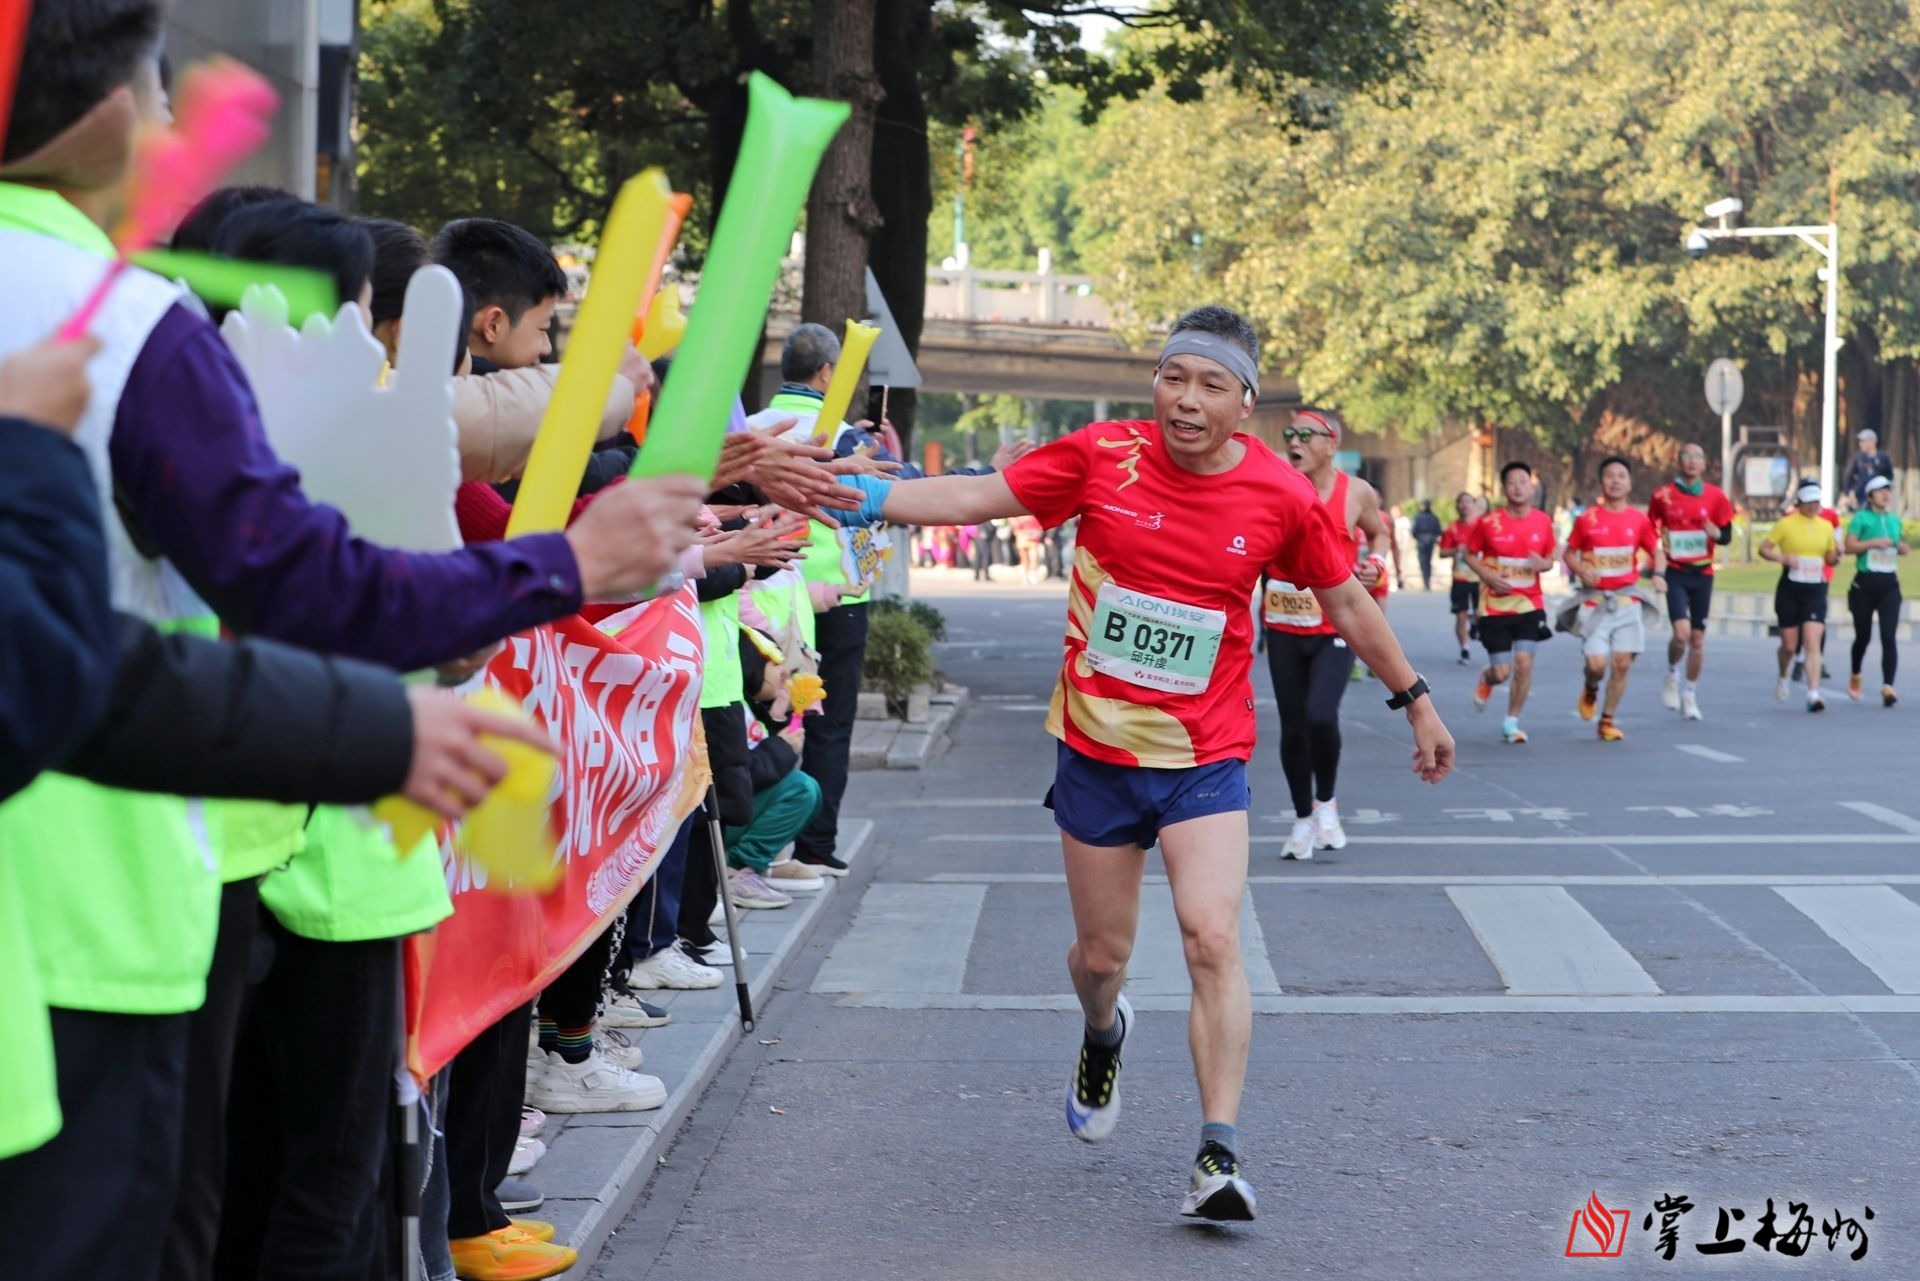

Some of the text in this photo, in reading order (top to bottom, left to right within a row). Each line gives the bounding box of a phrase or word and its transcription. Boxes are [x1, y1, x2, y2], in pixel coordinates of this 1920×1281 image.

[1270, 592, 1313, 610] C 0025
[1104, 611, 1127, 643] B
[1134, 624, 1195, 661] 0371
